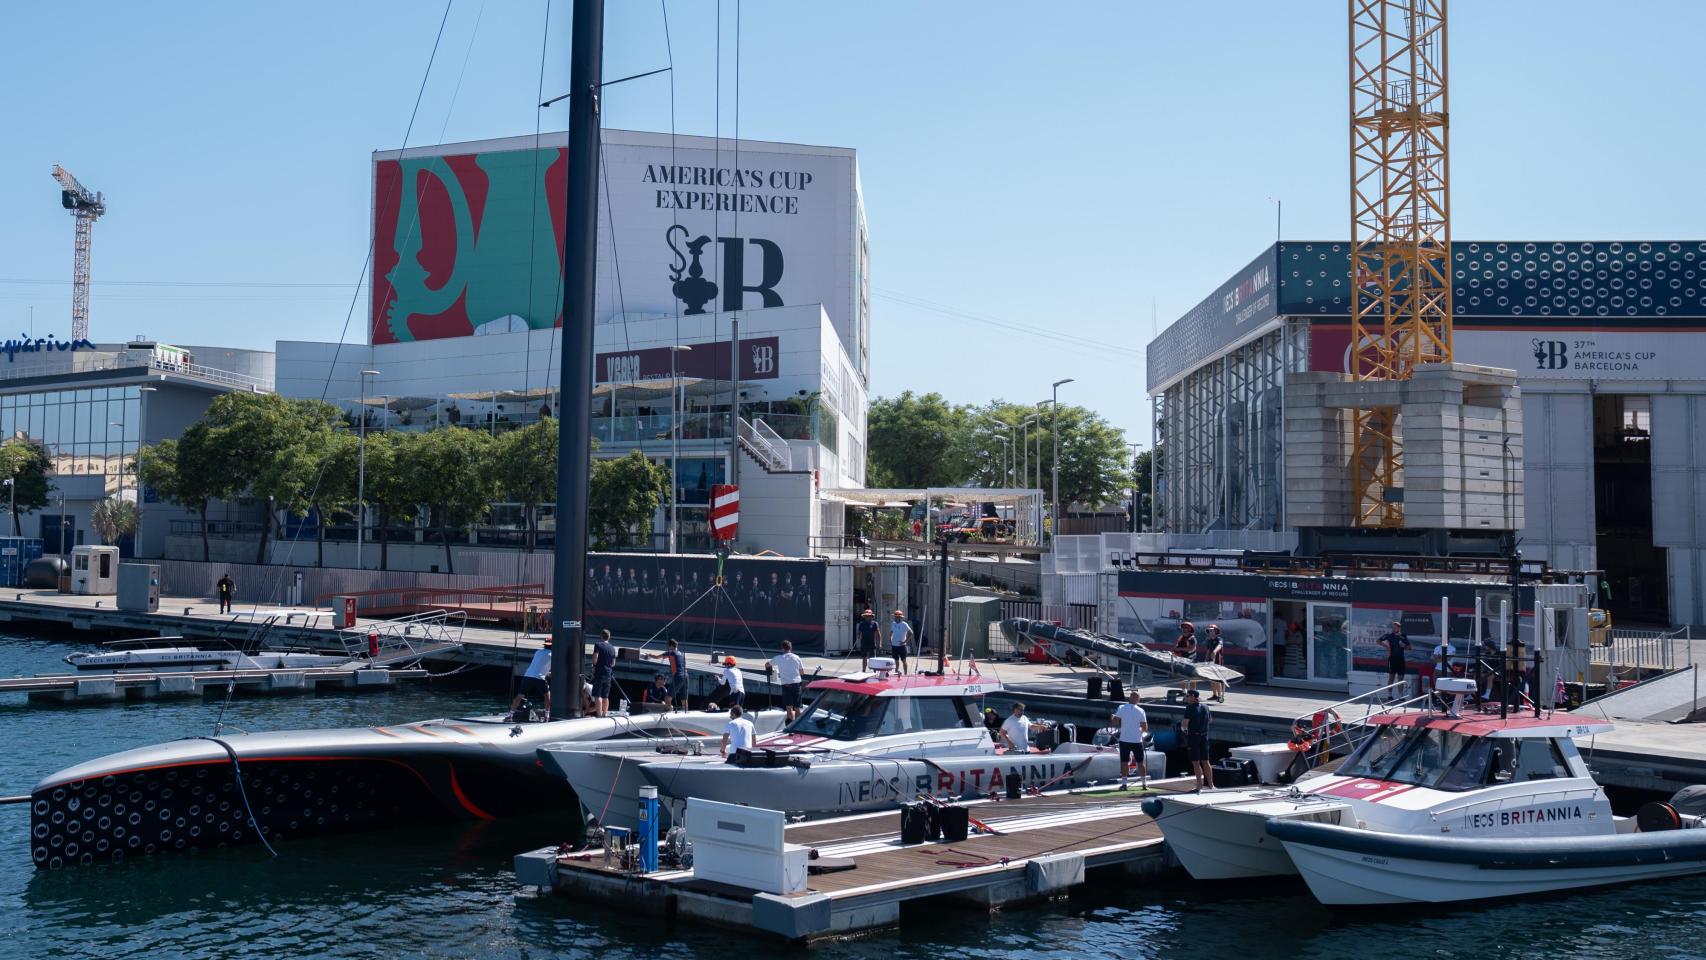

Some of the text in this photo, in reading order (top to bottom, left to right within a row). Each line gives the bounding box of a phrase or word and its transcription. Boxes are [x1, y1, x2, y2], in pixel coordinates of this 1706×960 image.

[642, 164, 813, 191] AMERICA'S CUP
[655, 189, 799, 215] EXPERIENCE
[0, 332, 96, 363] quàrium
[1574, 352, 1656, 360] AMERICA'S CUP
[1574, 362, 1639, 371] BARCELONA
[1291, 581, 1349, 592] BRITANNIA
[838, 776, 900, 806] INEOS
[1464, 806, 1582, 829] INEOS BRITANNIA
